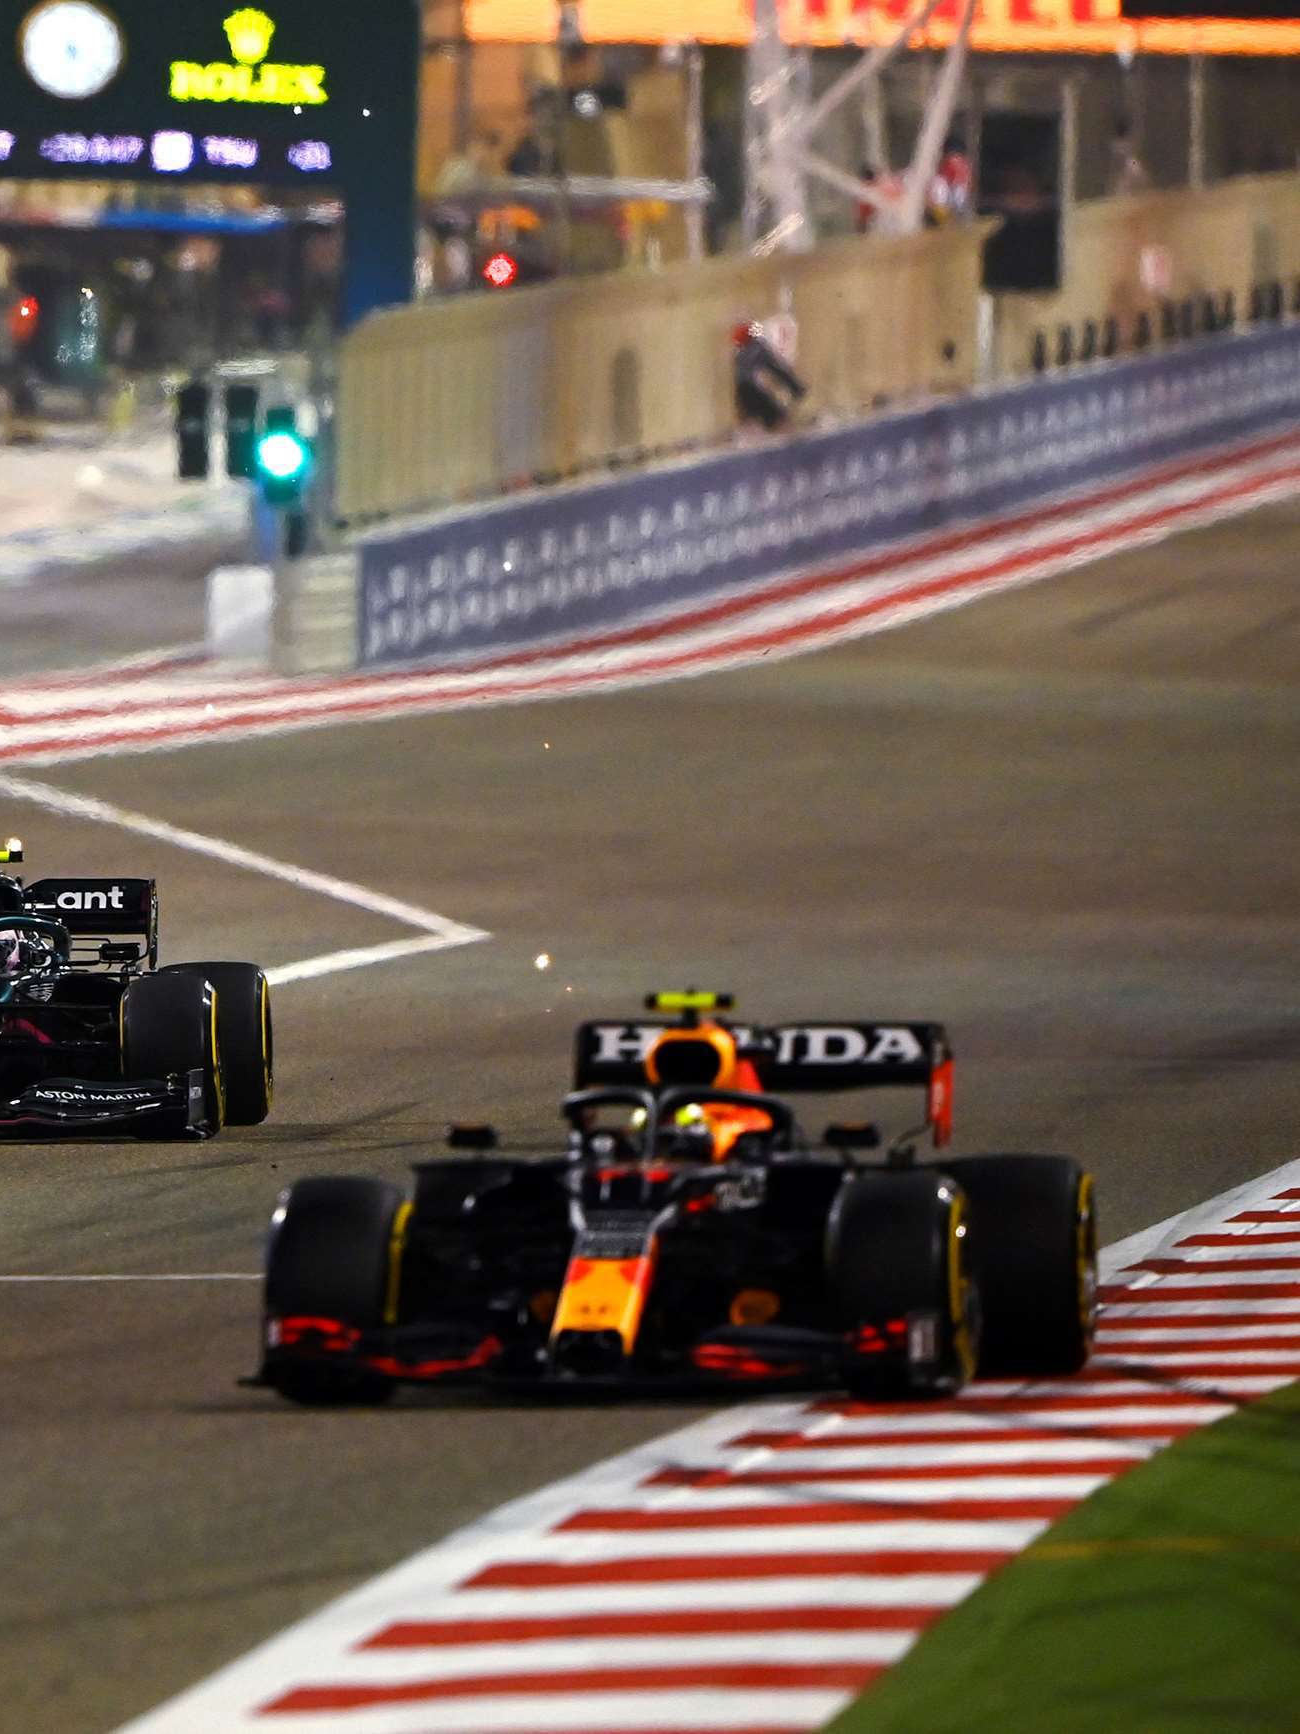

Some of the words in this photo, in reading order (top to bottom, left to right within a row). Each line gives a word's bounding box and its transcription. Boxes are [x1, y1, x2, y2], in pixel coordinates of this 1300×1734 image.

[170, 61, 329, 105] ROLEX
[35, 1090, 87, 1101] ASTON
[89, 1092, 151, 1101] MARTIN
